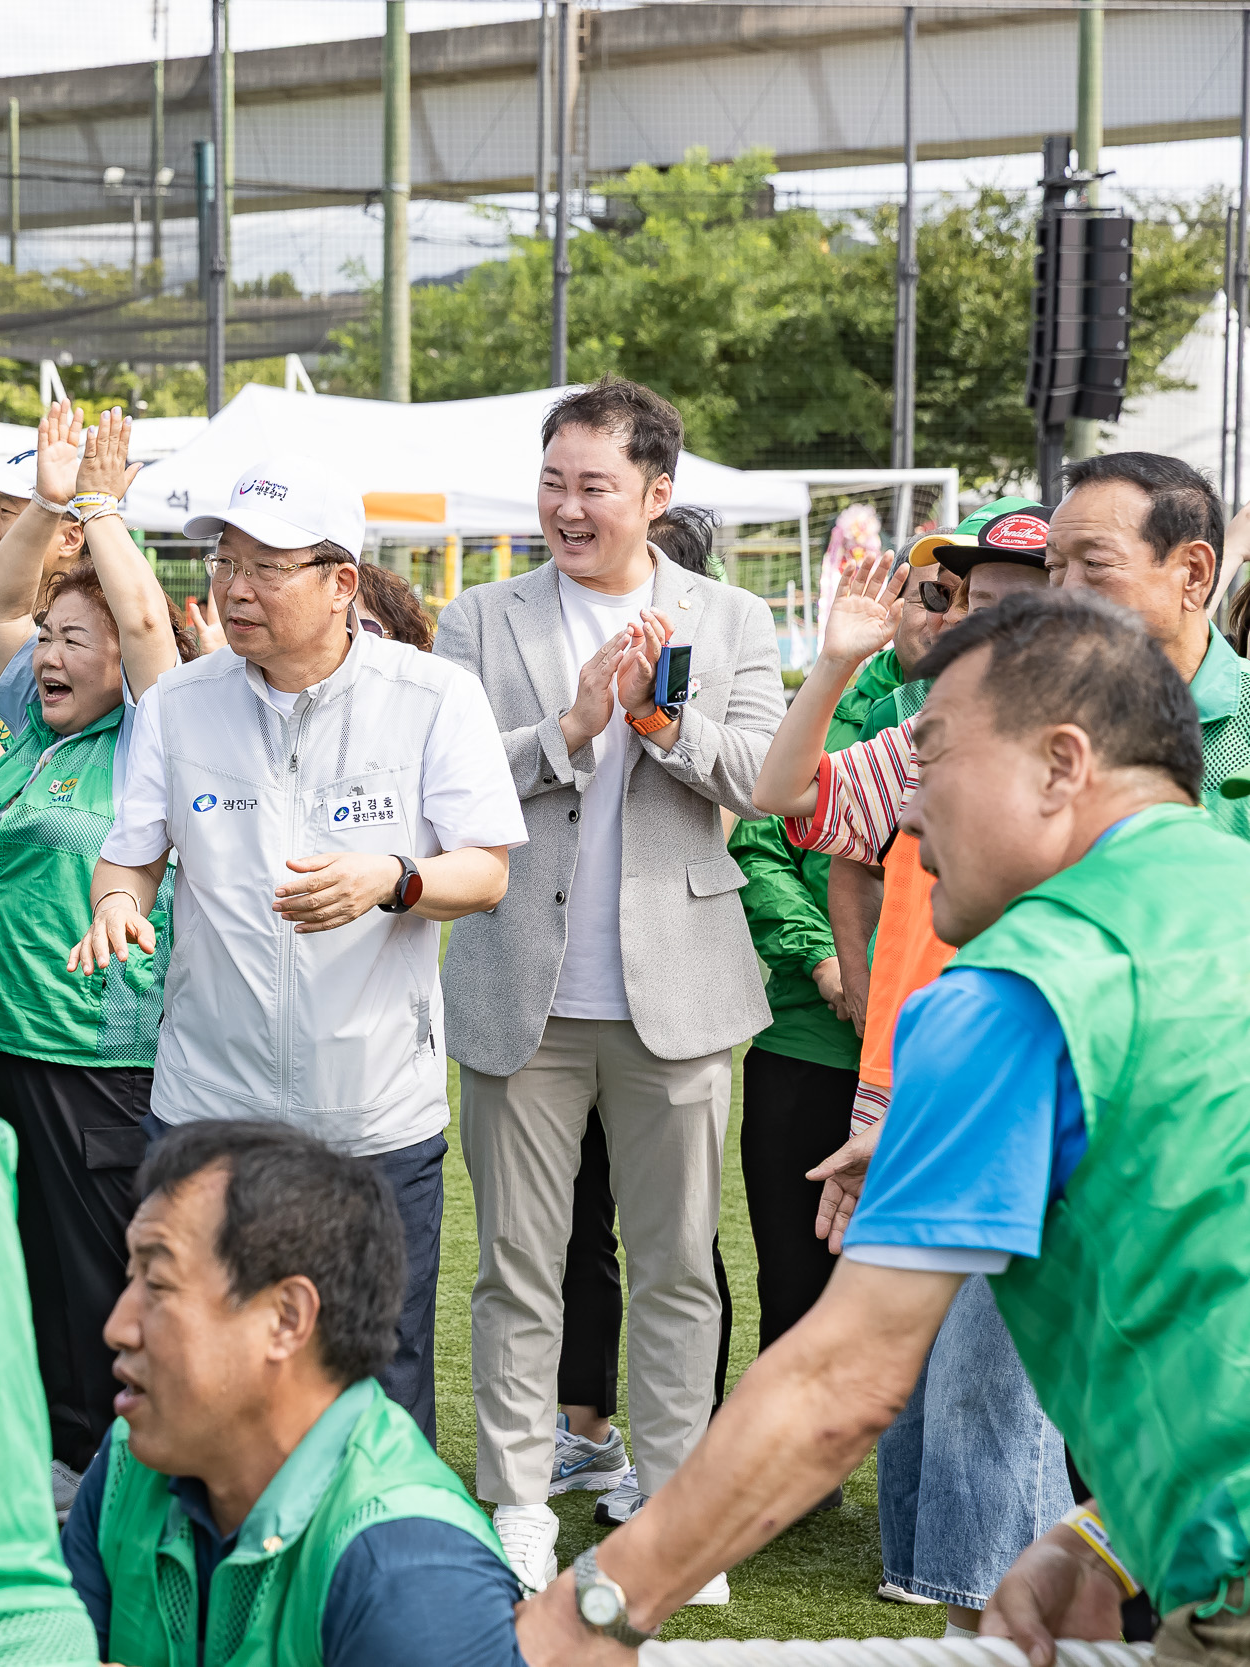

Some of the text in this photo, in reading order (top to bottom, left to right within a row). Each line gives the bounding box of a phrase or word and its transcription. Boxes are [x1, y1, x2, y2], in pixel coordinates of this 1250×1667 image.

[991, 522, 1045, 542] Jonathan
[222, 799, 258, 811] 광진구
[352, 810, 394, 823] 광진구청장
